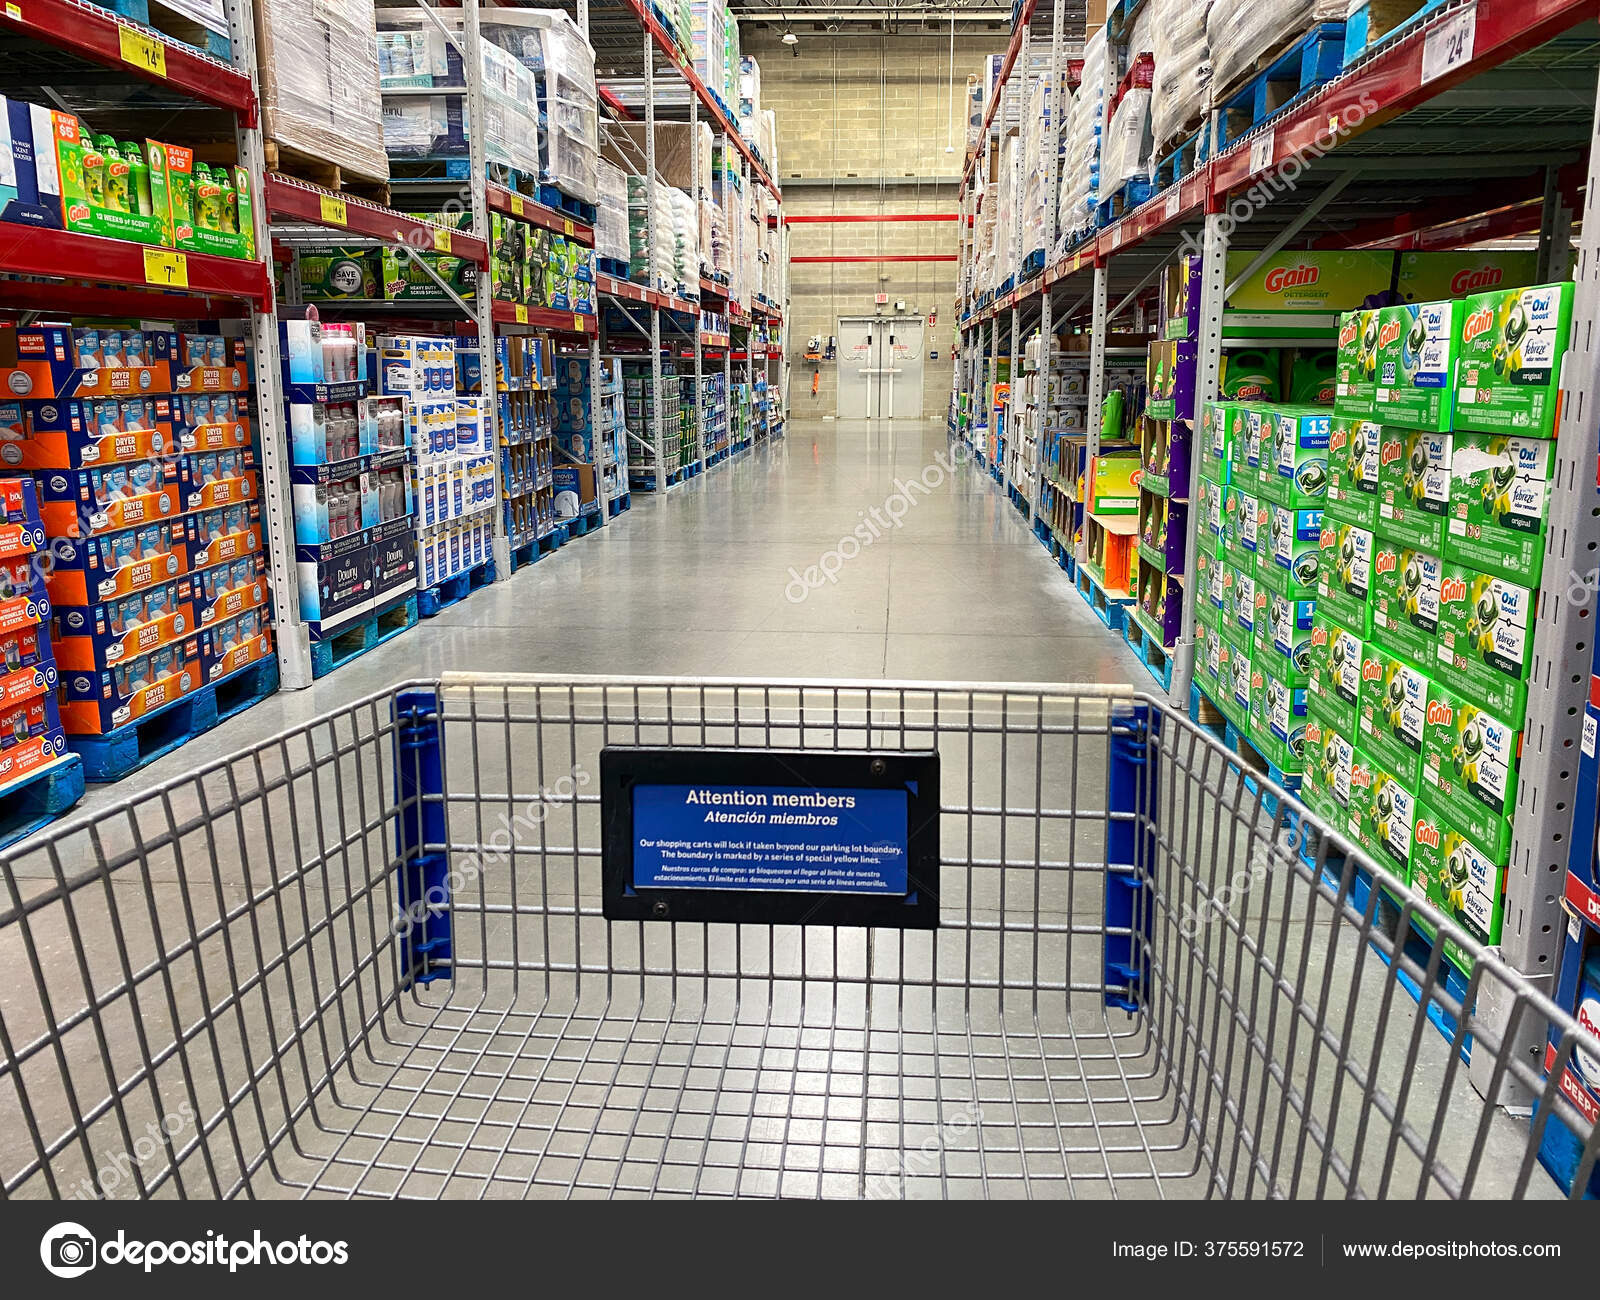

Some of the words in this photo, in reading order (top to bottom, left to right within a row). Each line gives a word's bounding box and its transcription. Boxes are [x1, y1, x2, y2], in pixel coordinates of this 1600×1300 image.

[58, 115, 76, 126] SAVE
[60, 125, 74, 138] $5
[169, 148, 189, 158] SAVE
[170, 156, 185, 168] $5
[70, 206, 90, 222] Gain
[104, 214, 123, 224] WEEKS
[176, 226, 193, 240] Gain
[1264, 264, 1320, 293] Gain
[1450, 266, 1503, 294] Gain
[1532, 296, 1551, 311] Oxi
[1429, 312, 1441, 324] Oxi
[1531, 311, 1550, 320] boost
[1463, 310, 1493, 344] Gain
[1340, 324, 1357, 349] Gain
[1379, 321, 1400, 350] Gain
[1525, 336, 1548, 356] febreze
[112, 379, 130, 387] SHEETS
[204, 378, 220, 386] SHEETS
[1522, 372, 1542, 381] original
[1238, 385, 1261, 398] Gain
[206, 428, 222, 436] DRYER
[116, 436, 135, 446] DRYER
[207, 435, 222, 444] SHEETS
[1330, 429, 1347, 453] Gain
[116, 445, 136, 454] SHEETS
[1381, 440, 1402, 466] Gain
[1430, 442, 1442, 454] Oxi
[1519, 447, 1538, 462] Oxi
[1519, 461, 1536, 470] boost
[214, 484, 229, 493] DRYER
[1513, 485, 1535, 503] febreze
[214, 491, 229, 500] SHEETS
[124, 501, 143, 511] DRYER
[124, 510, 144, 520] SHEETS
[1511, 517, 1531, 528] original
[220, 540, 235, 549] DRYER
[1320, 529, 1336, 550] Gain
[220, 547, 235, 556] SHEETS
[387, 549, 403, 563] Downy
[132, 563, 151, 574] DRYER
[1376, 550, 1396, 574] Gain
[1423, 560, 1436, 574] Oxi
[132, 573, 151, 583] SHEETS
[338, 566, 357, 582] Downy
[1440, 576, 1467, 604] Gain
[226, 593, 241, 603] DRYER
[1501, 590, 1519, 607] Oxi
[226, 600, 242, 610] SHEETS
[1501, 604, 1518, 616] boost
[140, 625, 158, 637] DRYER
[1311, 627, 1327, 647] Gain
[140, 634, 158, 646] SHEETS
[1496, 628, 1516, 648] febreze
[234, 646, 249, 656] DRYER
[234, 654, 249, 664] SHEETS
[1495, 658, 1513, 671] original
[1362, 658, 1382, 681] Gain
[1407, 678, 1419, 691] Oxi
[146, 685, 164, 698] DRYER
[146, 694, 165, 706] SHEETS
[1427, 700, 1453, 727] Gain
[1306, 723, 1321, 744] Gain
[1486, 727, 1502, 744] Oxi
[1486, 740, 1500, 753] boost
[1352, 764, 1370, 789] Gain
[686, 790, 767, 805] Attention
[773, 792, 855, 808] members
[704, 811, 766, 824] Atención
[769, 813, 838, 825] miembros
[1415, 819, 1440, 849] Gain
[640, 839, 654, 847] Our
[656, 840, 691, 849] shopping
[713, 841, 727, 849] will
[728, 841, 744, 849] lock
[776, 842, 804, 852] beyond
[821, 844, 850, 853] parking
[864, 845, 903, 855] boundary.
[661, 850, 676, 858] The
[677, 851, 713, 861] boundary
[715, 851, 721, 859] is
[723, 852, 751, 860] marked
[754, 852, 762, 861] by
[805, 855, 832, 864] special
[834, 855, 859, 864] yellow
[860, 856, 881, 864] lines.
[1564, 1074, 1590, 1111] DEEP
